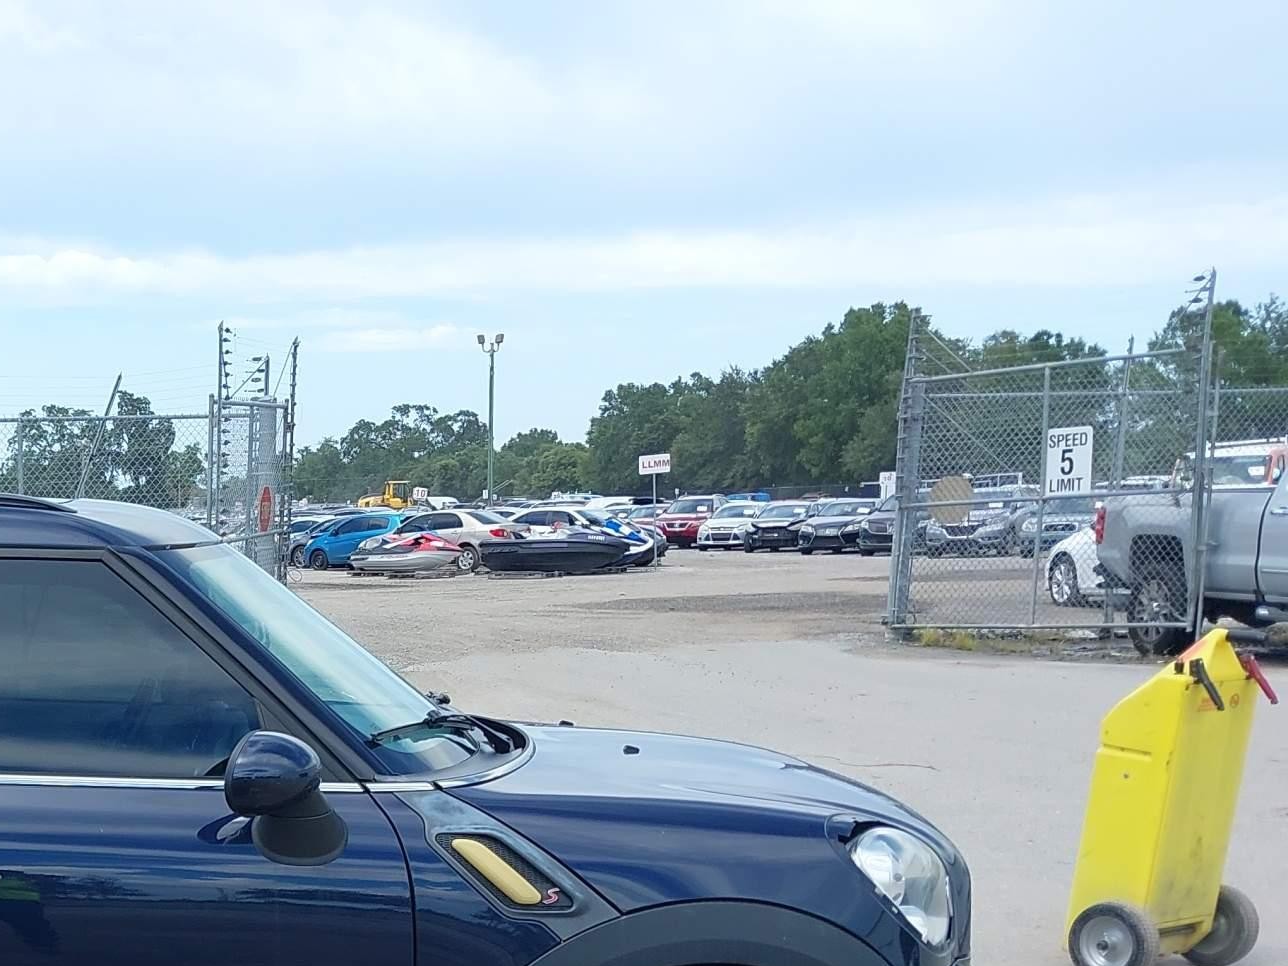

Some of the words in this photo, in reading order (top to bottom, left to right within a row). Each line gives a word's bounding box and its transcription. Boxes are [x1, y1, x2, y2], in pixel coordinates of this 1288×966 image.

[1048, 431, 1088, 449] SPEED
[642, 459, 670, 469] LLMM
[1060, 448, 1074, 476] 5
[1049, 477, 1084, 493] LIMIT
[542, 887, 560, 905] S
